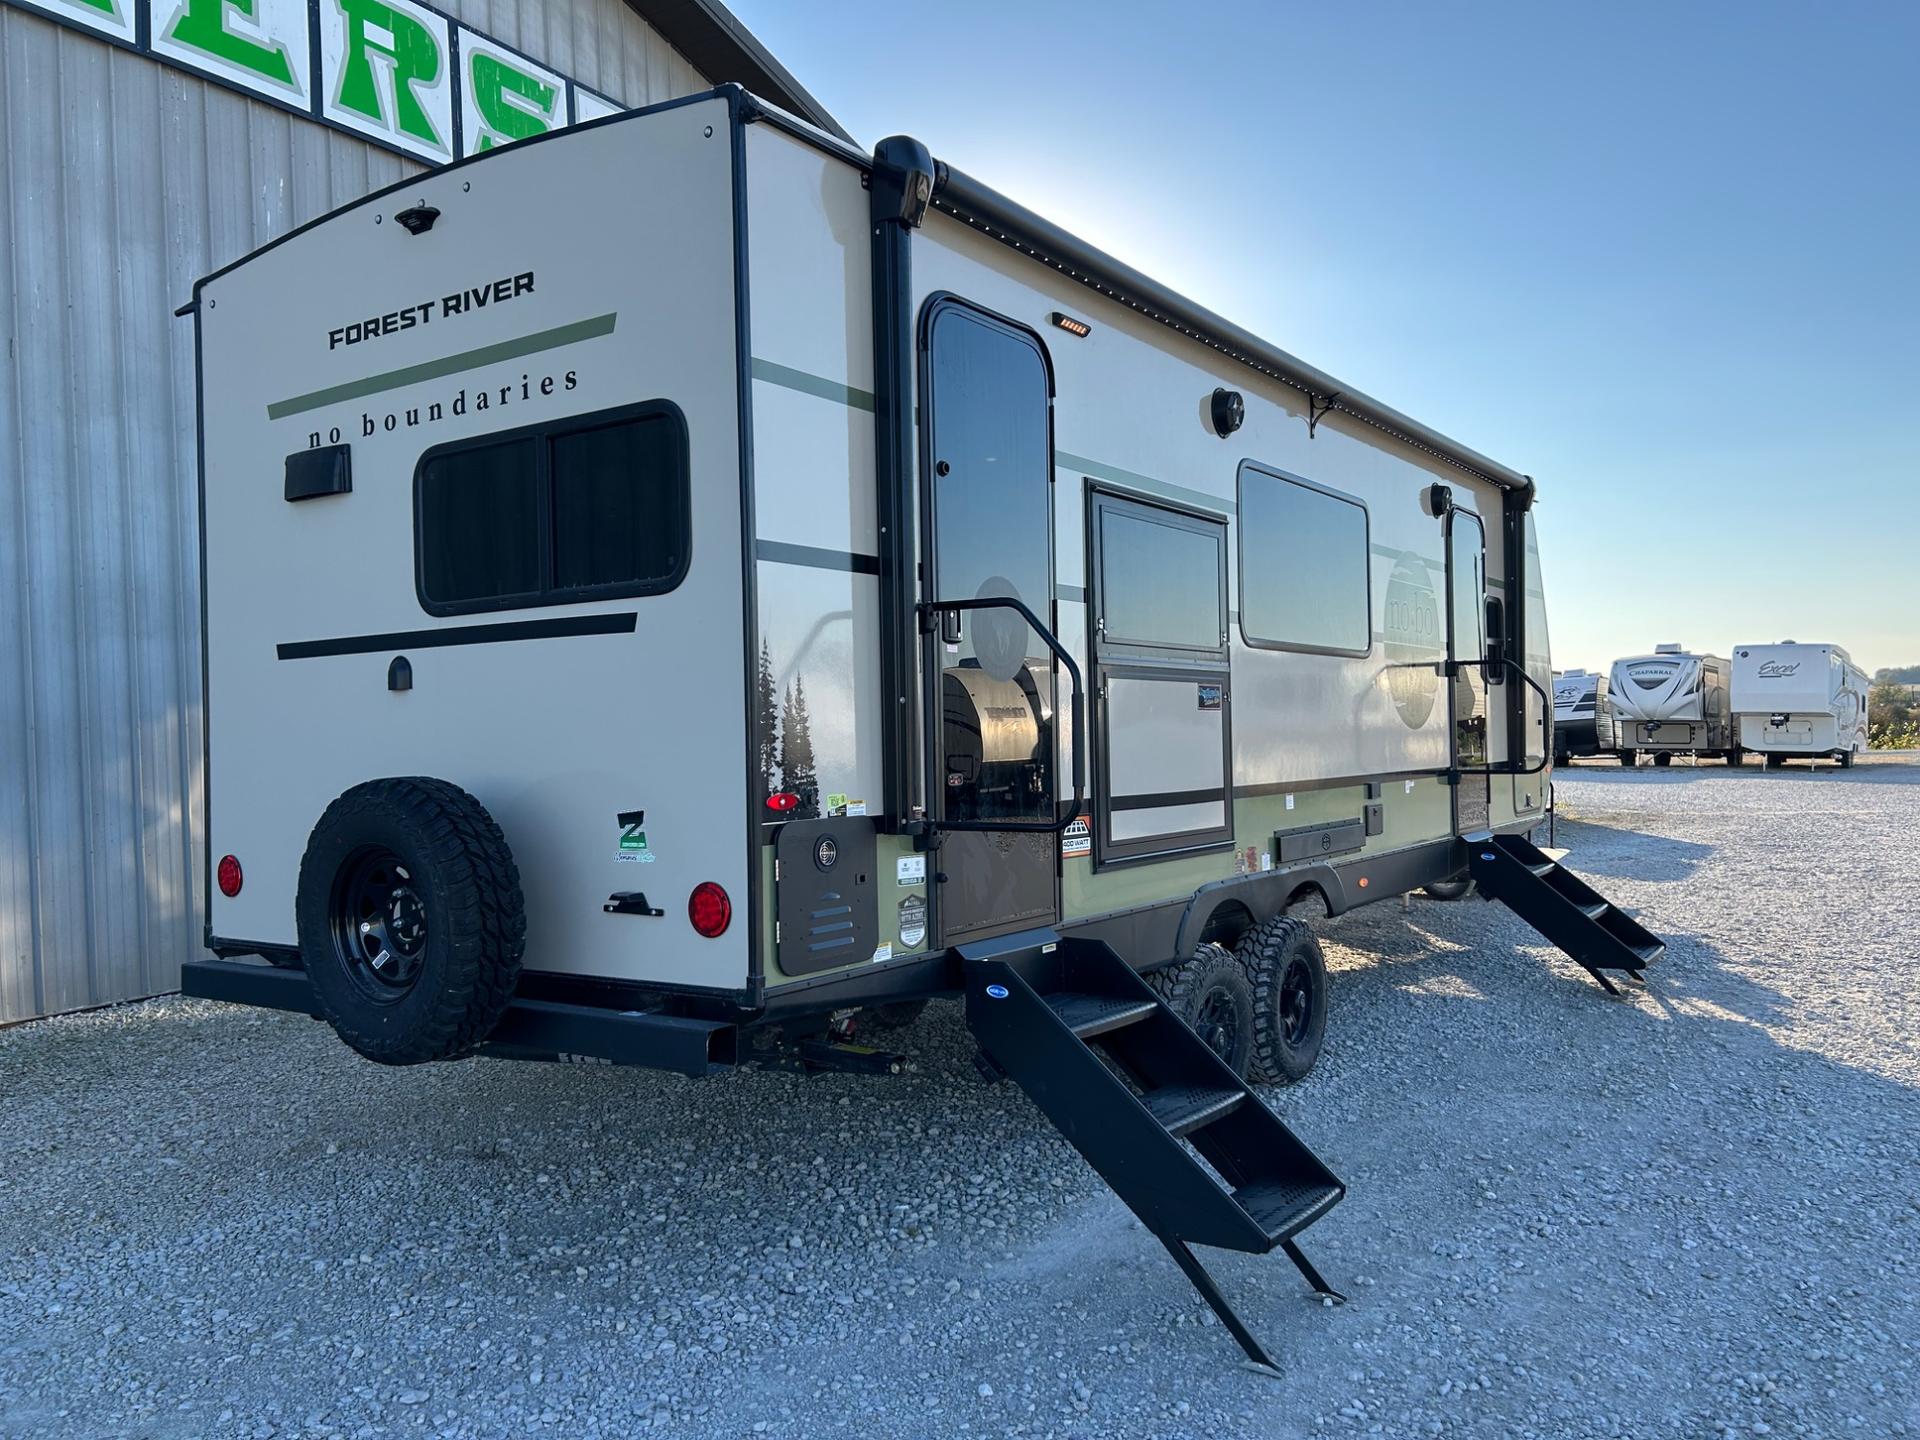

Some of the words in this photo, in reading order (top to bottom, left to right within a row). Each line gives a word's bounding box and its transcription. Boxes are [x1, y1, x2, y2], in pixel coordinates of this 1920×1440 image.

[60, 0, 566, 158] ERS
[328, 301, 436, 350] FOREST
[441, 271, 535, 318] RIVER
[308, 426, 341, 448] no
[361, 369, 577, 437] boundaries
